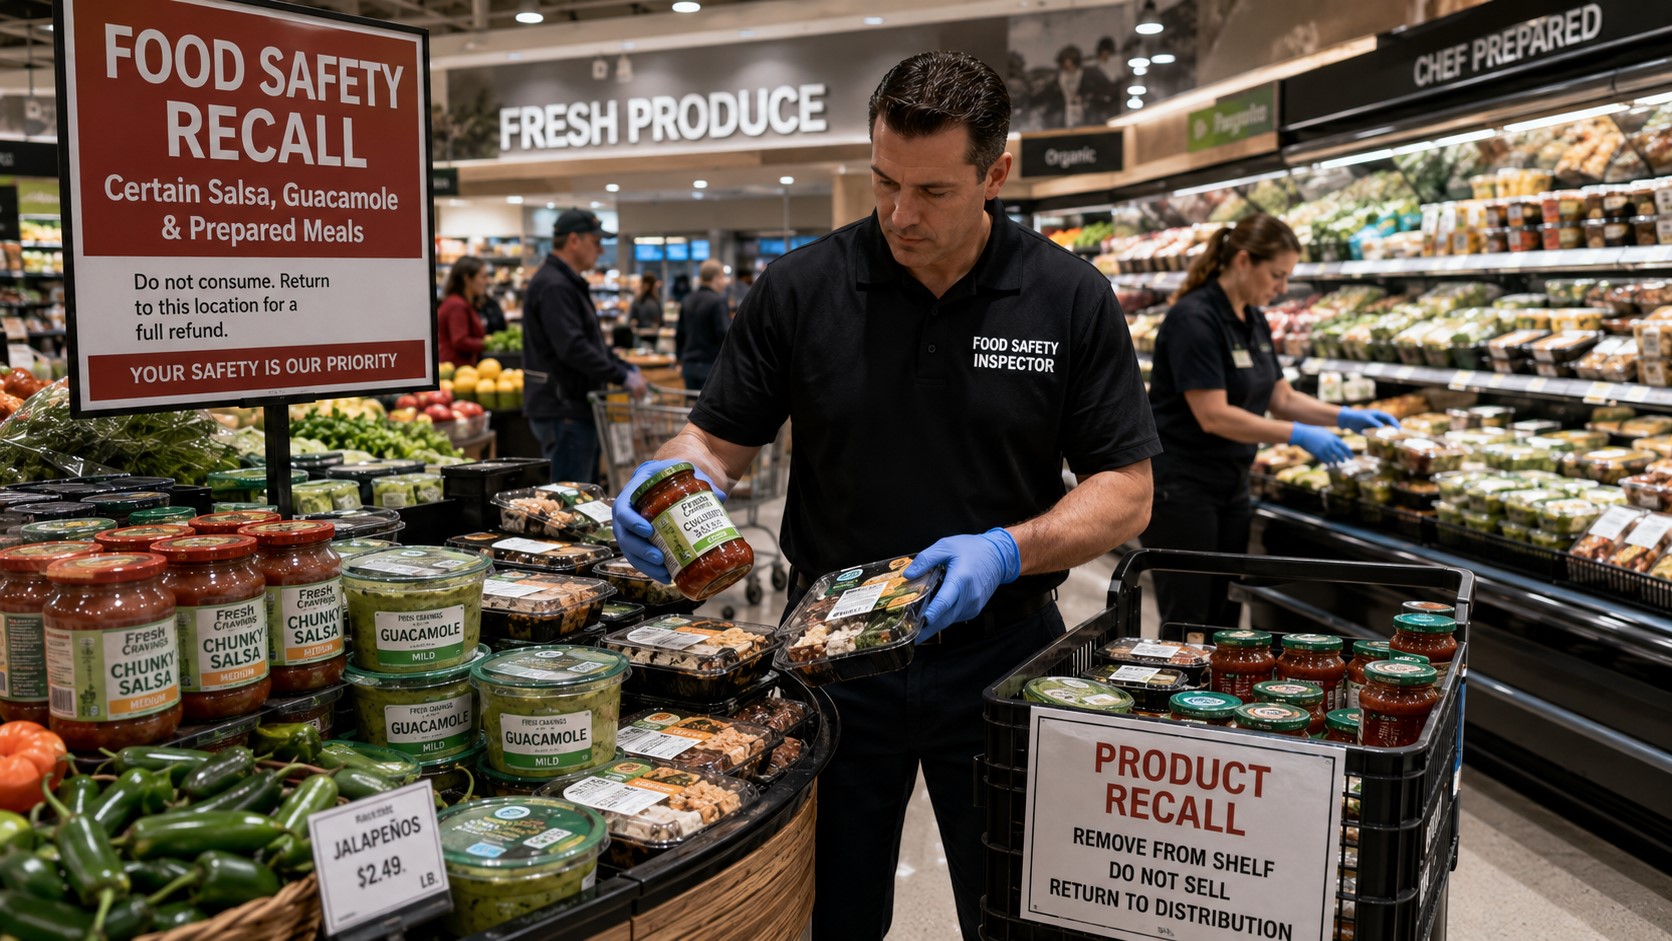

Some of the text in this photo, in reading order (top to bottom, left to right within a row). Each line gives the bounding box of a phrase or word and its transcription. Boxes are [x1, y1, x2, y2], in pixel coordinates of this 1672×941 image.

[1413, 3, 1603, 87] CHEF PREPARED
[105, 23, 404, 109] FOOD SAFETY
[500, 83, 828, 151] FRESH PRODUCE
[167, 100, 367, 168] RECALL
[1045, 145, 1097, 169] Organic
[104, 174, 398, 210] Certain Salsa, Guacamole
[161, 214, 364, 247] & Prepared Meals
[134, 273, 330, 290] Do not consume. Return
[135, 296, 298, 316] to this location for a
[136, 322, 228, 341] full refund.
[973, 336, 1059, 355] FOOD SAFETY
[130, 353, 397, 384] YOUR SAFETY IS OUR PRIORITY
[974, 353, 1054, 373] INSPECTOR
[288, 606, 341, 630] CHUNKY
[203, 628, 264, 653] CHUNKY
[295, 623, 338, 645] SALSA
[381, 621, 460, 642] GUACAMOLE
[111, 650, 175, 679] CHUNKY
[211, 646, 261, 669] SALSA
[412, 651, 436, 661] MILD
[119, 670, 173, 696] SALSA
[391, 710, 469, 735] GUACAMOLE
[422, 741, 445, 753] MILD
[505, 728, 587, 747] GUACAMOLE
[535, 757, 559, 767] MILD
[1094, 742, 1271, 798] PRODUCT
[1105, 783, 1246, 836] RECALL
[334, 815, 421, 861] JALAPEÑOS
[1073, 827, 1275, 878] REMOVE FROM SHELF
[420, 872, 439, 889] LB.
[1109, 861, 1231, 901] DO NOT SELL
[1049, 878, 1292, 941] RETURN TO DISTRIBUTION
